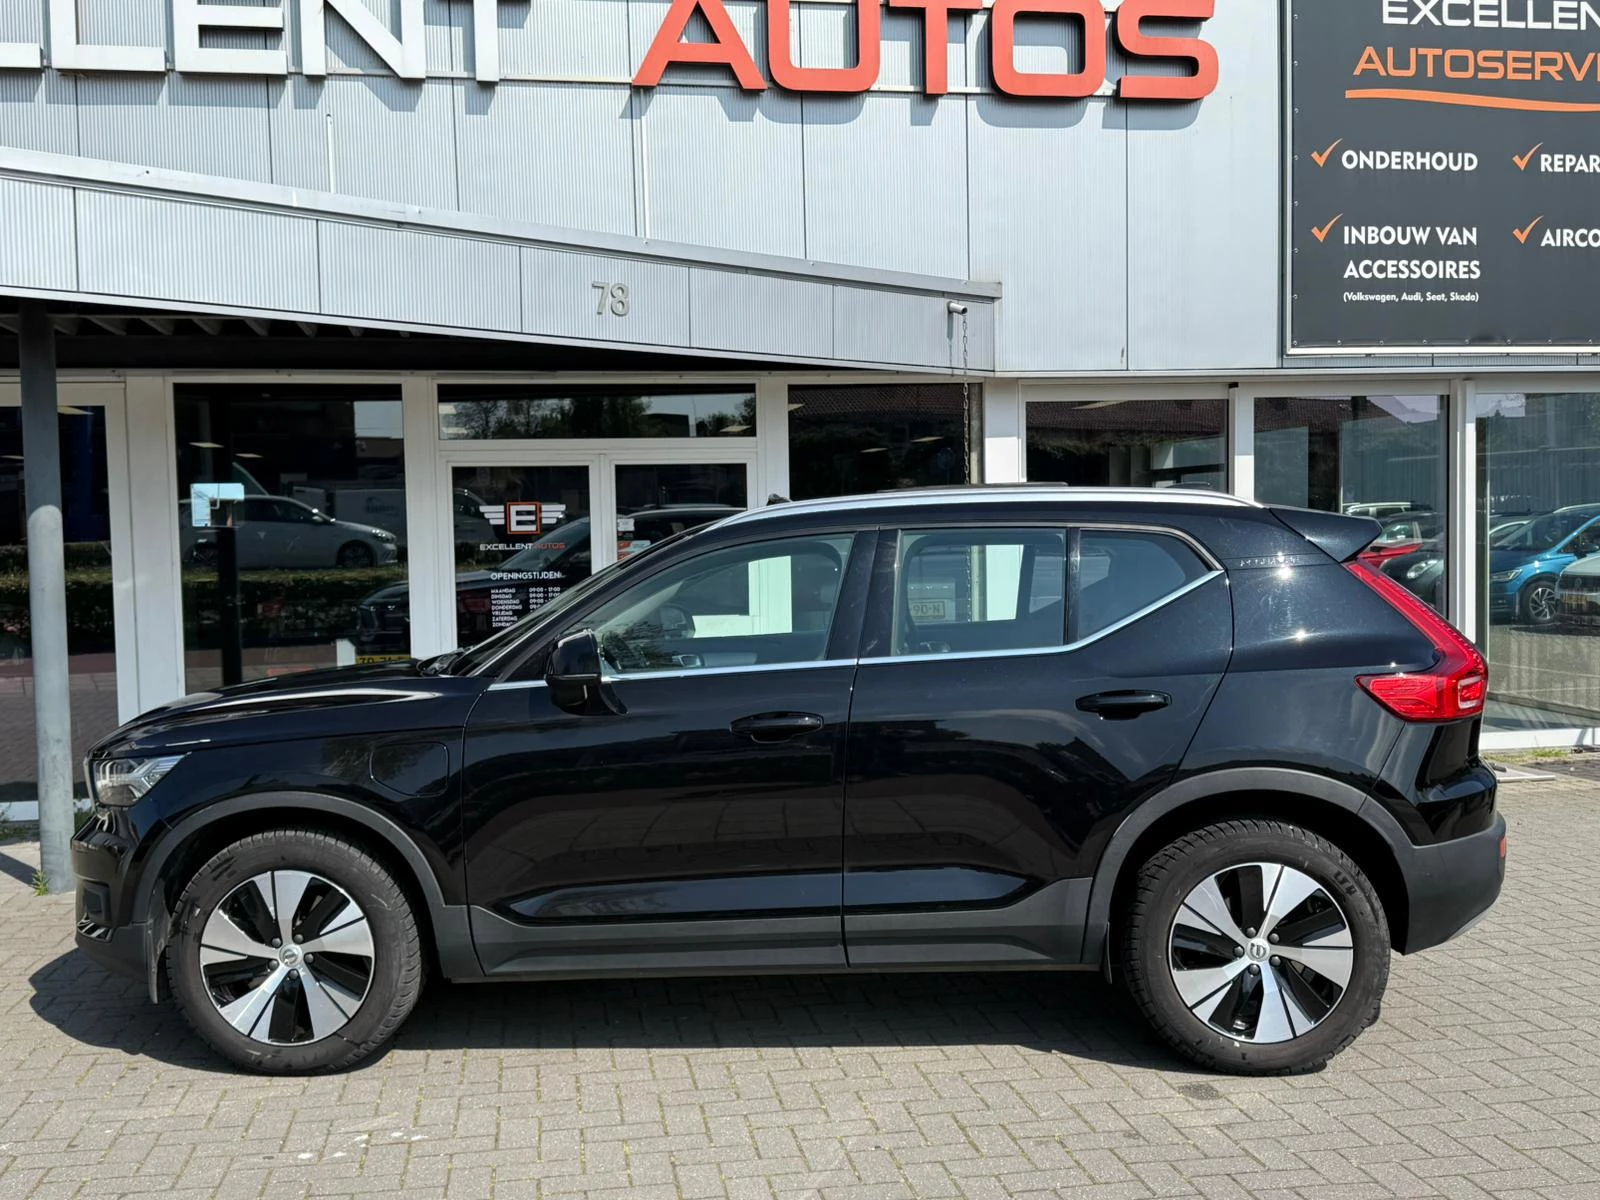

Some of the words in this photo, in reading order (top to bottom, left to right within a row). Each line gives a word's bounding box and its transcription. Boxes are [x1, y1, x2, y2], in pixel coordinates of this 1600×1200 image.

[1382, 0, 1600, 30] EXCELLEN
[632, 0, 1219, 98] AUTOS
[1341, 150, 1478, 171] ONDERHOUD
[1540, 153, 1600, 173] REPAR
[1344, 226, 1431, 245] INBOUW
[1435, 227, 1477, 246] VAN
[1540, 228, 1600, 248] AIRCO
[1343, 260, 1481, 279] ACCESSOIRES
[592, 281, 630, 317] 78
[1343, 292, 1399, 303] (Volkswagen,
[1401, 292, 1424, 302] Audi,
[1426, 292, 1448, 302] Seat,
[1450, 292, 1479, 302] Skoda)
[480, 543, 532, 551] EXCELLENT
[490, 571, 560, 580] OPENINGSTIJDEN
